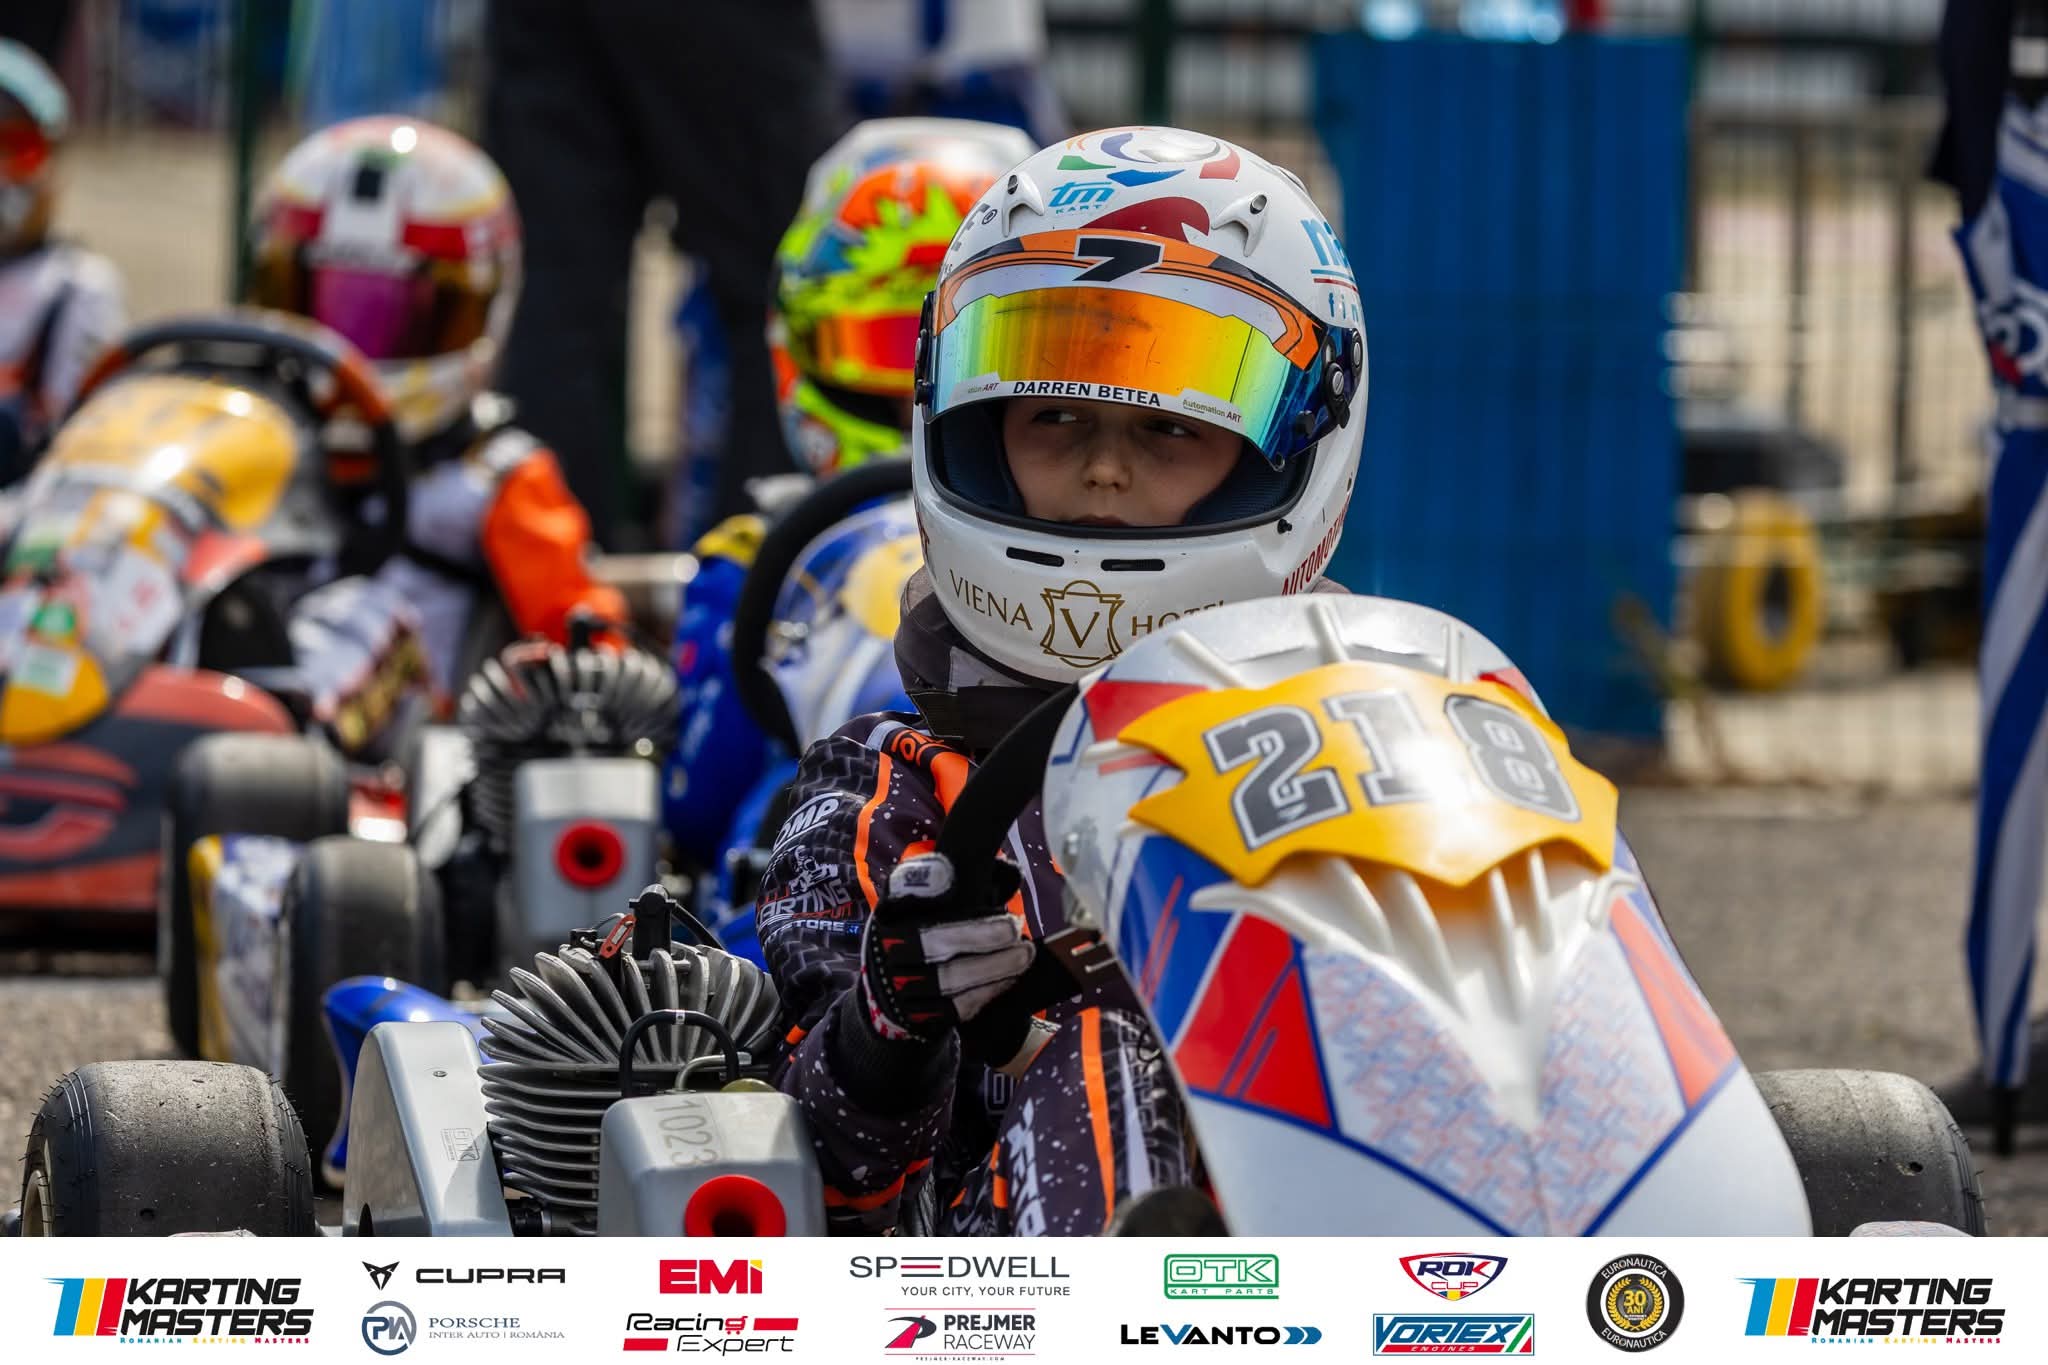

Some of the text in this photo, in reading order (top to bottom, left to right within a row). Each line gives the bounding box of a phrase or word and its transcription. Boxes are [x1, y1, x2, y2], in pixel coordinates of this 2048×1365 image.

[1071, 234, 1166, 282] 7
[1012, 381, 1161, 407] DARREN BETEA
[1182, 399, 1226, 417] Automation
[1226, 411, 1242, 423] ART
[949, 568, 1034, 632] VIENA
[1202, 687, 1582, 853] 218
